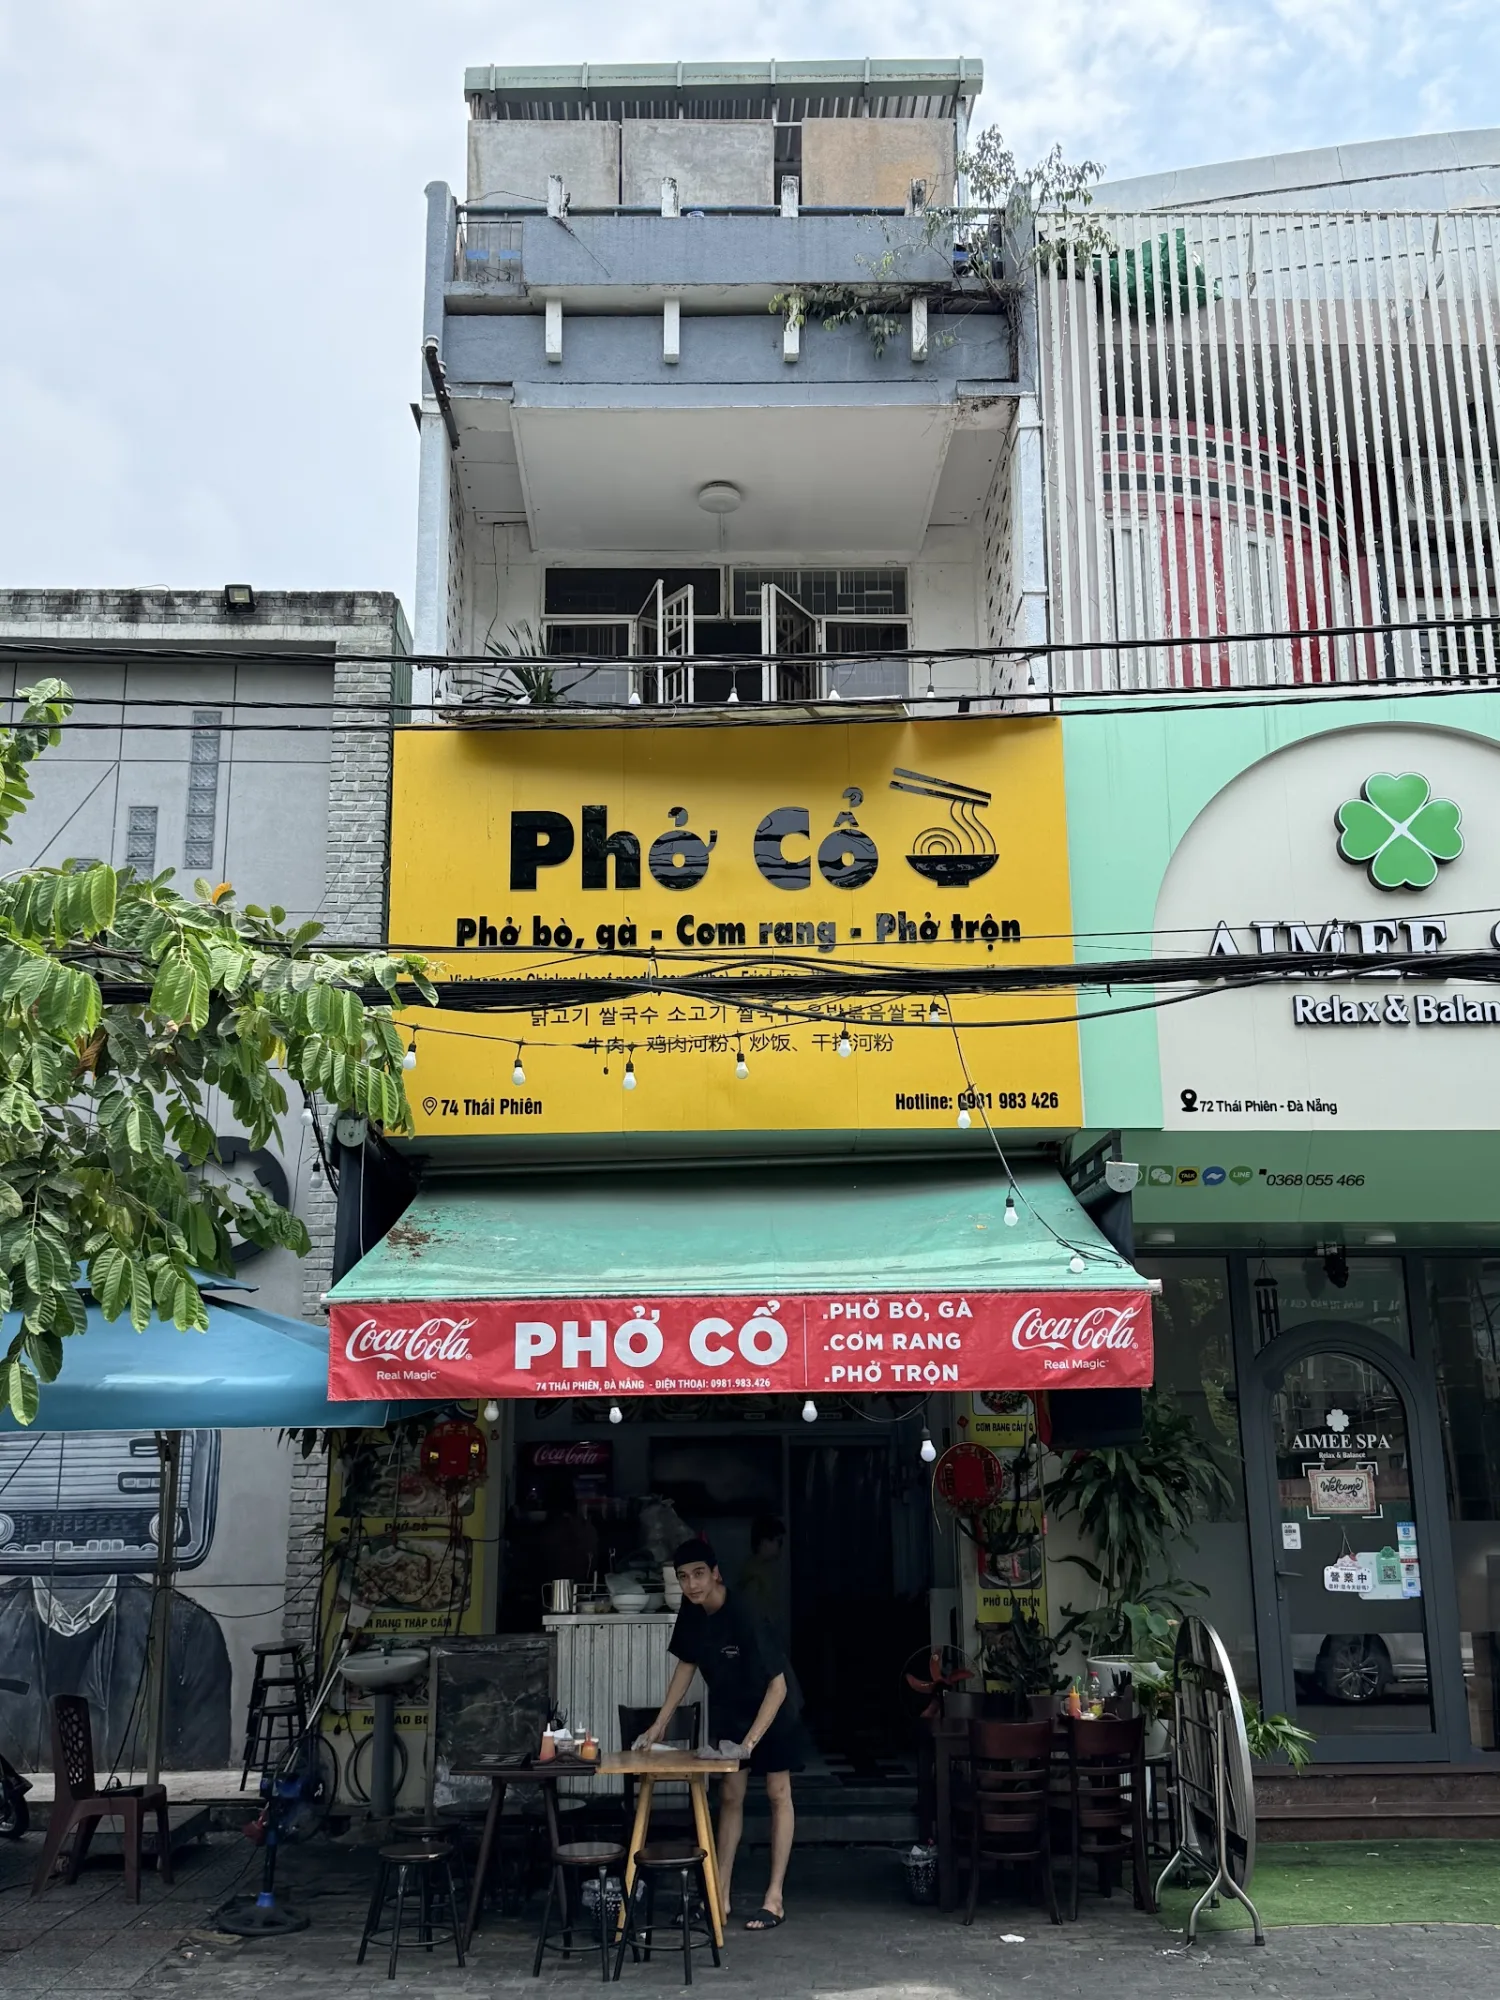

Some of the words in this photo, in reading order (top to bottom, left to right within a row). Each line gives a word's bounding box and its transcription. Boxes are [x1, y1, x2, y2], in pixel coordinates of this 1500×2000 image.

[510, 804, 718, 892] Phở
[753, 786, 880, 891] Cổ
[456, 914, 522, 947] Phở
[532, 914, 585, 950] bò,
[595, 916, 638, 951] gà
[676, 914, 746, 946] Cơm
[758, 919, 837, 953] rang
[875, 911, 941, 944] Phở
[951, 913, 1021, 952] trộn
[531, 1006, 589, 1027] 닭고기
[599, 1006, 659, 1026] 쌀국수
[667, 1005, 727, 1024] 소고기
[1293, 995, 1382, 1026] Relax
[1384, 995, 1411, 1026] &
[441, 1099, 459, 1116] 74
[463, 1097, 495, 1116] Thái
[500, 1097, 543, 1115] Phiên
[895, 1092, 953, 1110] Hotline:
[999, 1092, 1027, 1109] 983
[1031, 1092, 1059, 1109] 426
[1200, 1100, 1214, 1112] 72
[1216, 1099, 1242, 1112] Thái
[1245, 1099, 1278, 1112] Phiên
[1287, 1099, 1304, 1112] Đà
[1307, 1097, 1338, 1115] Nẵng
[1266, 1174, 1302, 1186] 0368
[1305, 1174, 1333, 1186] 055
[1336, 1174, 1365, 1186] 466
[889, 1297, 930, 1322] BÒ,
[938, 1297, 973, 1319] GÀ
[514, 1305, 664, 1370] PHỞ
[689, 1299, 788, 1366] CỔ
[892, 1332, 962, 1350] RANG
[891, 1360, 959, 1385] TRỘN
[1044, 1358, 1069, 1370] Real
[376, 1370, 401, 1381] Real
[536, 1382, 547, 1391] 74
[549, 1379, 571, 1391] THÁI
[604, 1379, 618, 1391] ĐÀ
[655, 1378, 676, 1390] ĐIỆN
[679, 1378, 708, 1390] THOẠI:
[711, 1378, 770, 1388] 0981.983.426
[992, 1422, 1010, 1432] RANG
[1292, 1433, 1352, 1449] AIMEE
[1355, 1433, 1391, 1449] SPA
[1318, 1451, 1335, 1459] Relax
[1342, 1451, 1366, 1459] Balance
[1320, 1476, 1364, 1498] Welcome
[375, 1617, 401, 1629] RANG
